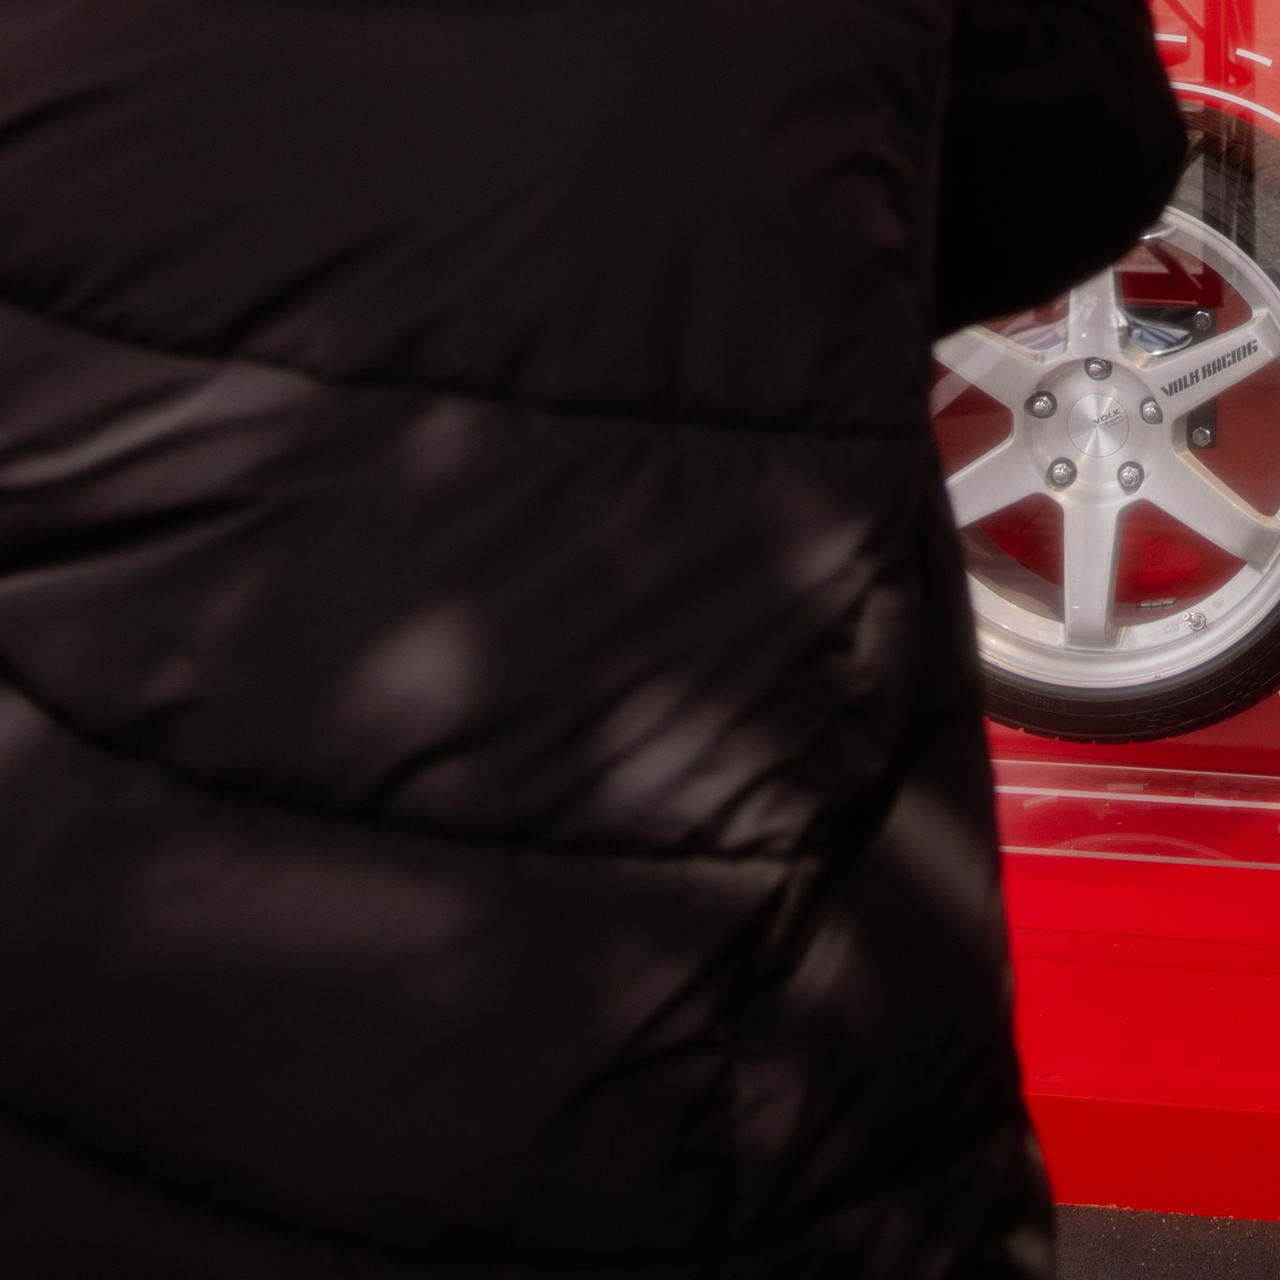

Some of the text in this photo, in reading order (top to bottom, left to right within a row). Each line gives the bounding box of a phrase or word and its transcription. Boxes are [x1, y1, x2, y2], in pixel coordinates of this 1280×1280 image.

[1160, 338, 1259, 397] VOLK RACING
[1093, 408, 1121, 424] VOLK
